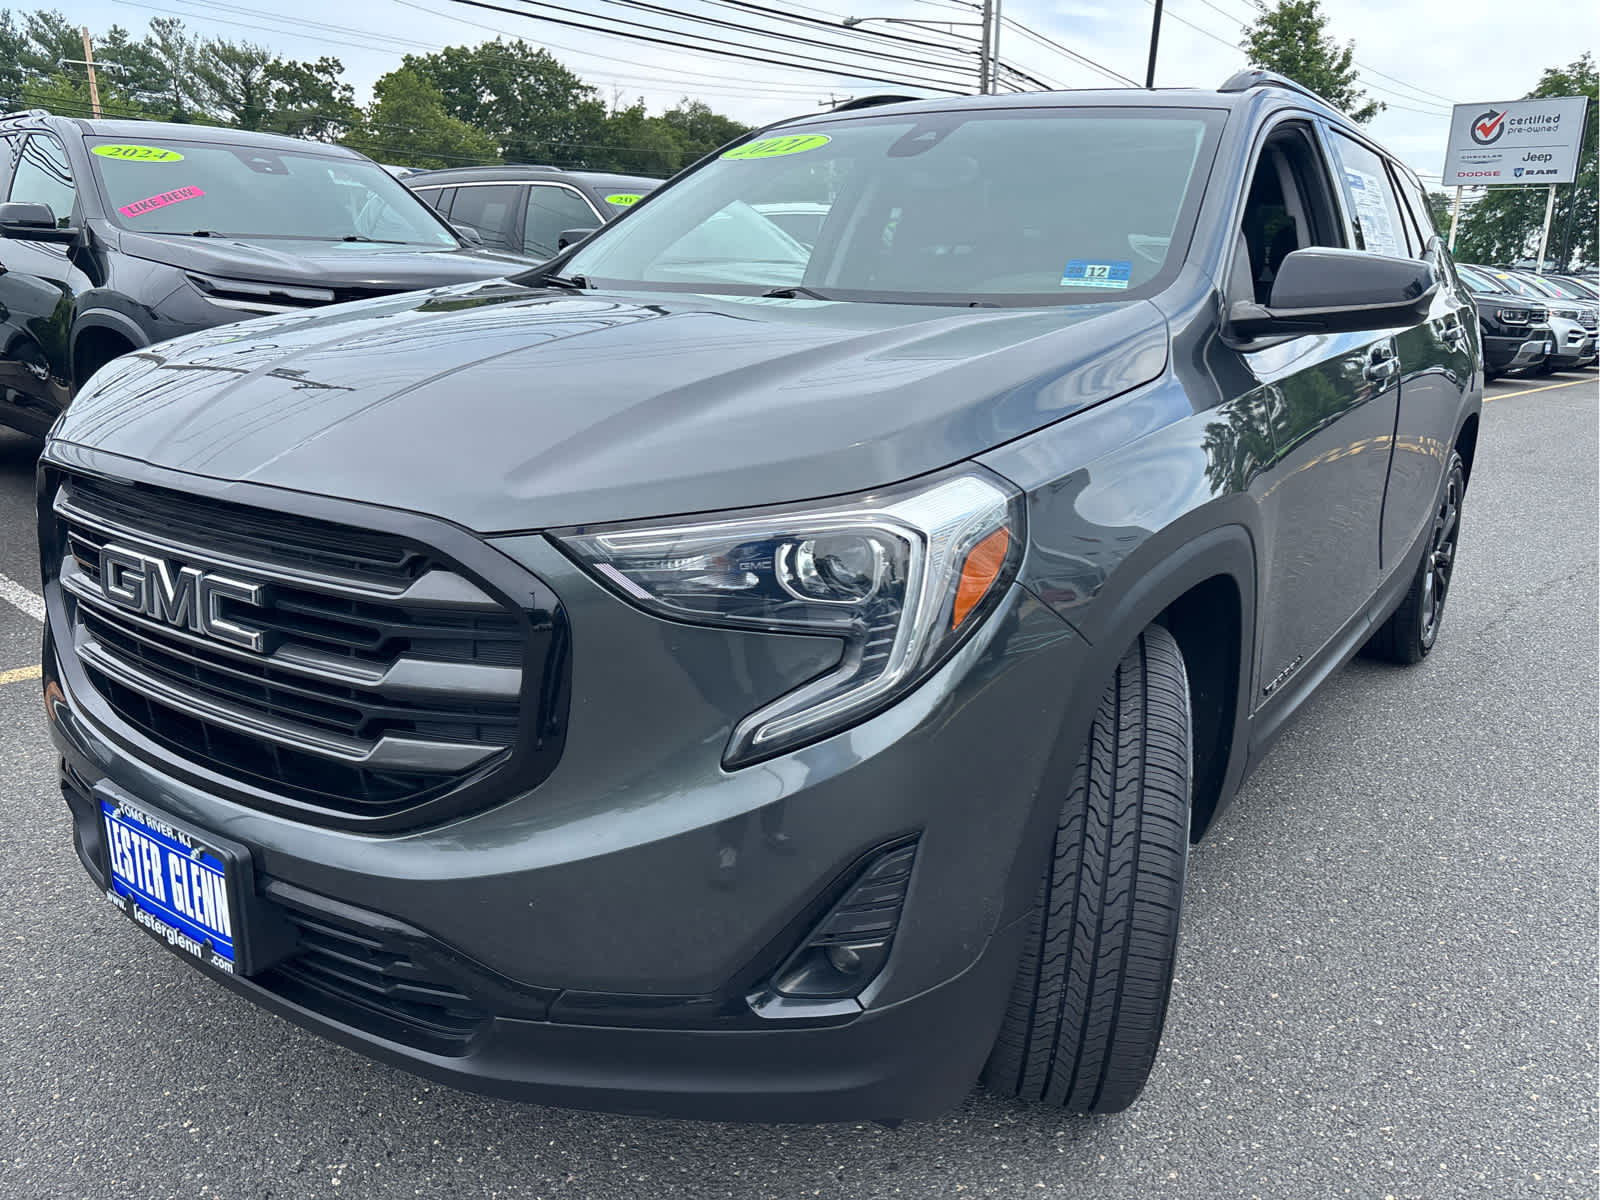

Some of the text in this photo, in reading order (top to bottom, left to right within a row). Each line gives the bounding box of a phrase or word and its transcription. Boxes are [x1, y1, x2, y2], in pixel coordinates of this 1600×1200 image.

[1509, 114, 1561, 125] certified
[1507, 125, 1559, 135] pre-owned
[108, 147, 170, 160] 2024
[1522, 152, 1552, 163] Jeep
[127, 187, 194, 215] LIKE NEW
[1087, 266, 1107, 277] 12
[739, 561, 772, 570] GMC
[100, 544, 265, 654] GMC
[118, 802, 193, 848] TOMS RIVER, NJ
[104, 816, 233, 937] LESTER GLENN
